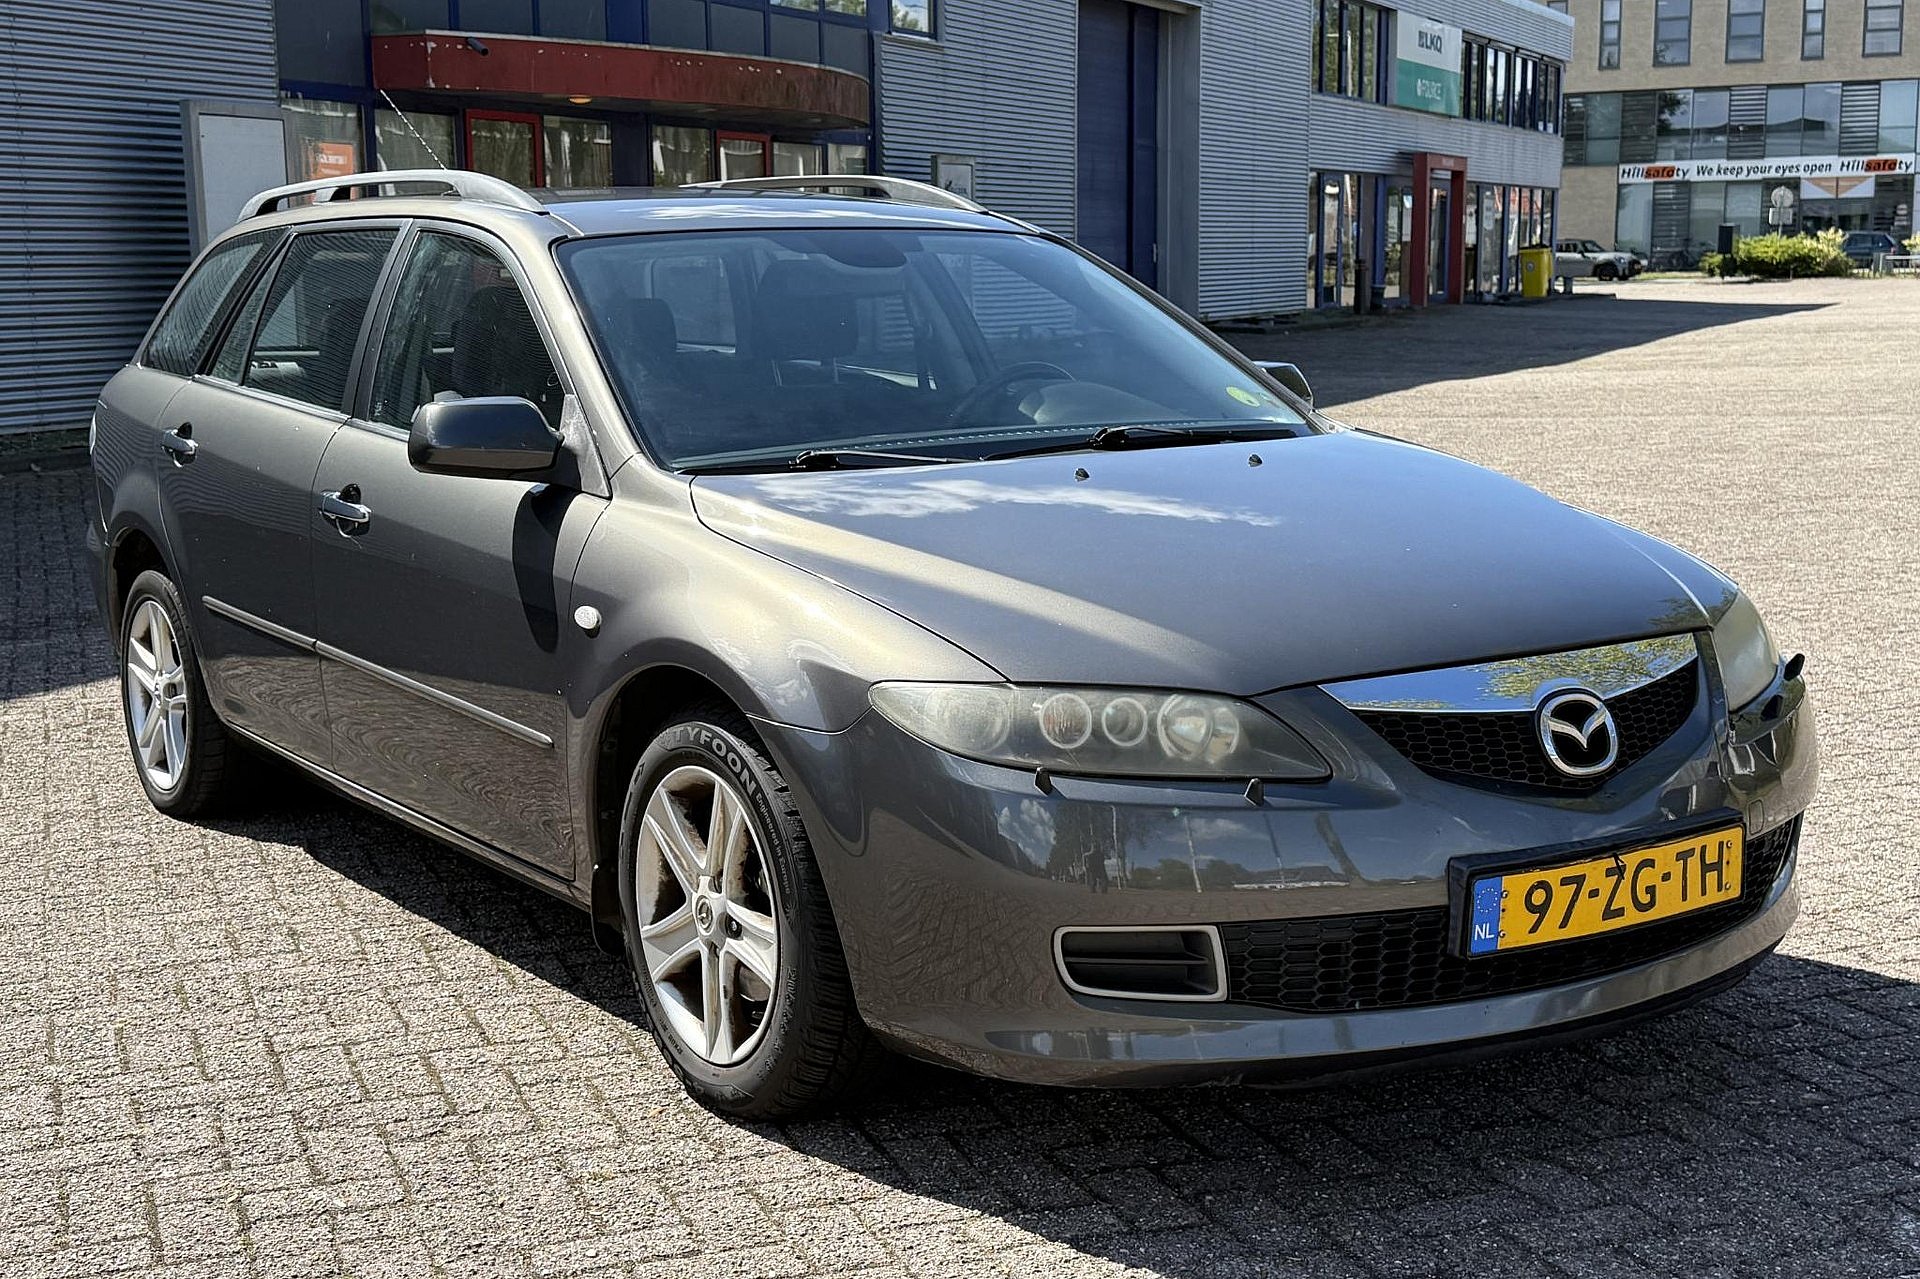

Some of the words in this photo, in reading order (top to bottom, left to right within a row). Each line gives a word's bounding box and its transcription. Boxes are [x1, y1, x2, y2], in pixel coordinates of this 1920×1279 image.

[1621, 165, 1690, 180] Hillsafety
[1696, 165, 1714, 177] We
[1716, 163, 1743, 178] keep
[1745, 164, 1773, 178] your
[1774, 163, 1800, 176] eyes
[1803, 162, 1832, 175] open
[1839, 158, 1913, 173] Hillsafety
[674, 726, 757, 797] TYFOON
[755, 792, 780, 846] Engineered
[1524, 841, 1725, 935] 97-ZG-TH
[1474, 922, 1495, 941] NL
